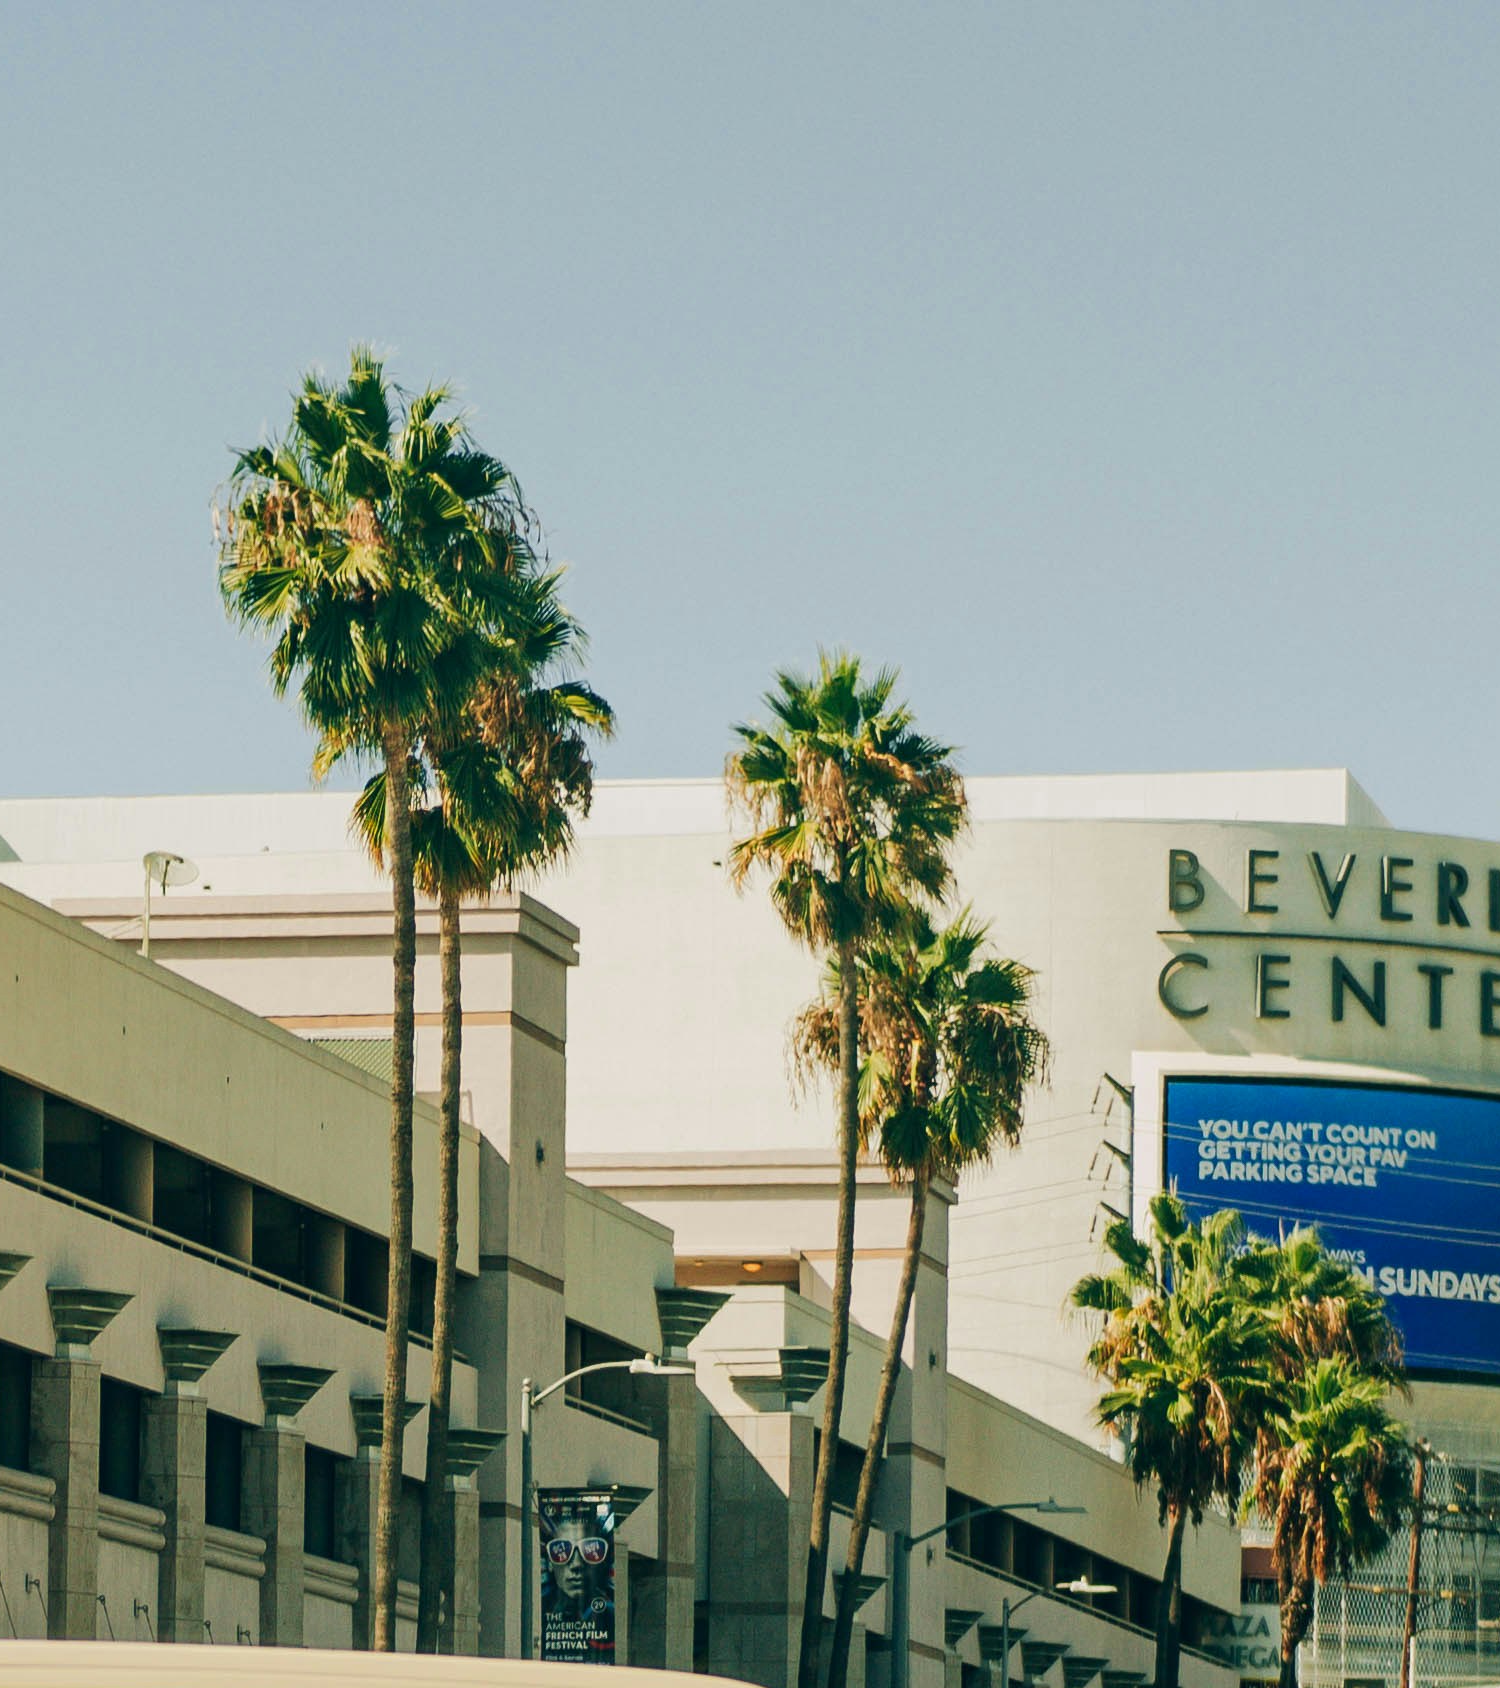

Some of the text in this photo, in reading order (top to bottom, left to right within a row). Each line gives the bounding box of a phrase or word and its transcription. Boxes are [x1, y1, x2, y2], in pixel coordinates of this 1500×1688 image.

[1198, 1119, 1437, 1150] YOU CAN'T COUNT ON
[1198, 1140, 1408, 1169] GETTING YOUR FAV
[1198, 1160, 1378, 1188] PARKING SPACE
[545, 1612, 563, 1621] THE
[545, 1621, 596, 1631] AMERICAN
[545, 1630, 608, 1640] FRENCH FILM
[545, 1640, 588, 1650] FESTIVAL
